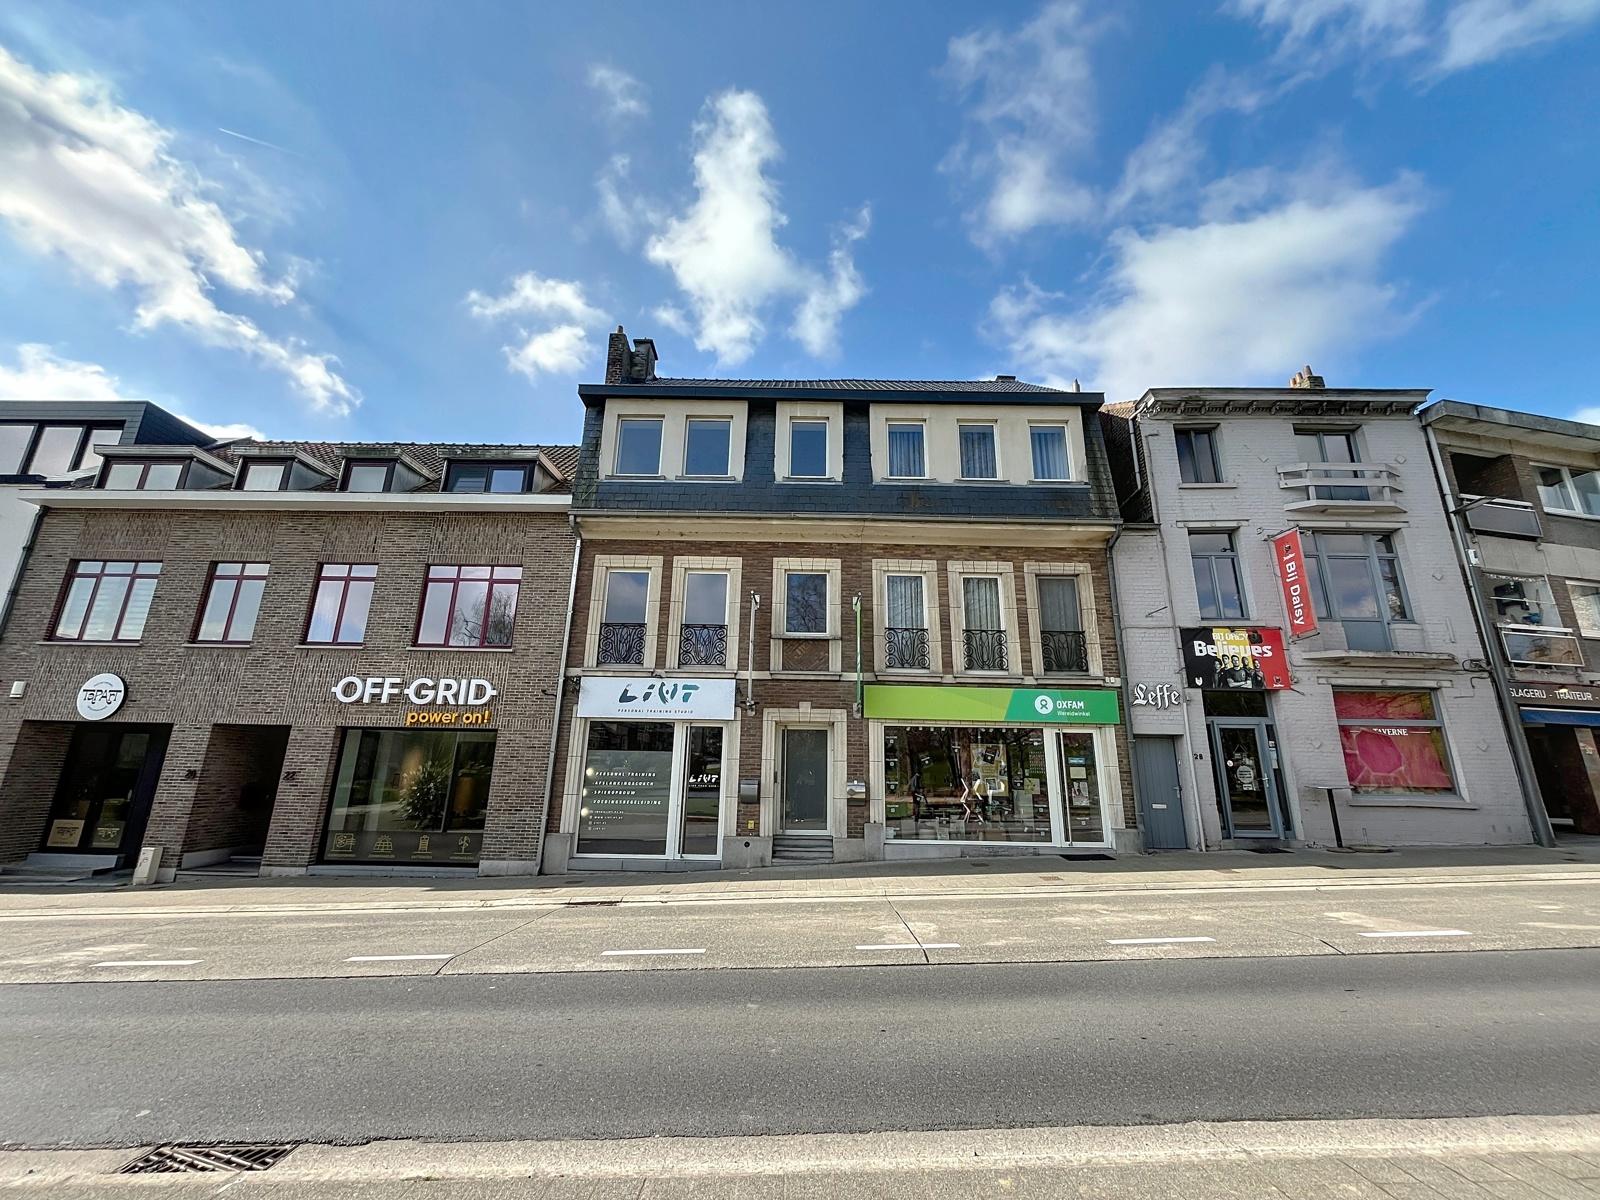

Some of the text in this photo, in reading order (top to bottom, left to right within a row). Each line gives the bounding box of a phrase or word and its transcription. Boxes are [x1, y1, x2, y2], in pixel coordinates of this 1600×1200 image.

[1290, 584, 1305, 625] Daisy
[1132, 682, 1180, 710] Leffe
[1554, 690, 1593, 701] TRAITEUR
[1056, 700, 1084, 709] OXFAM
[407, 710, 491, 726] power on!
